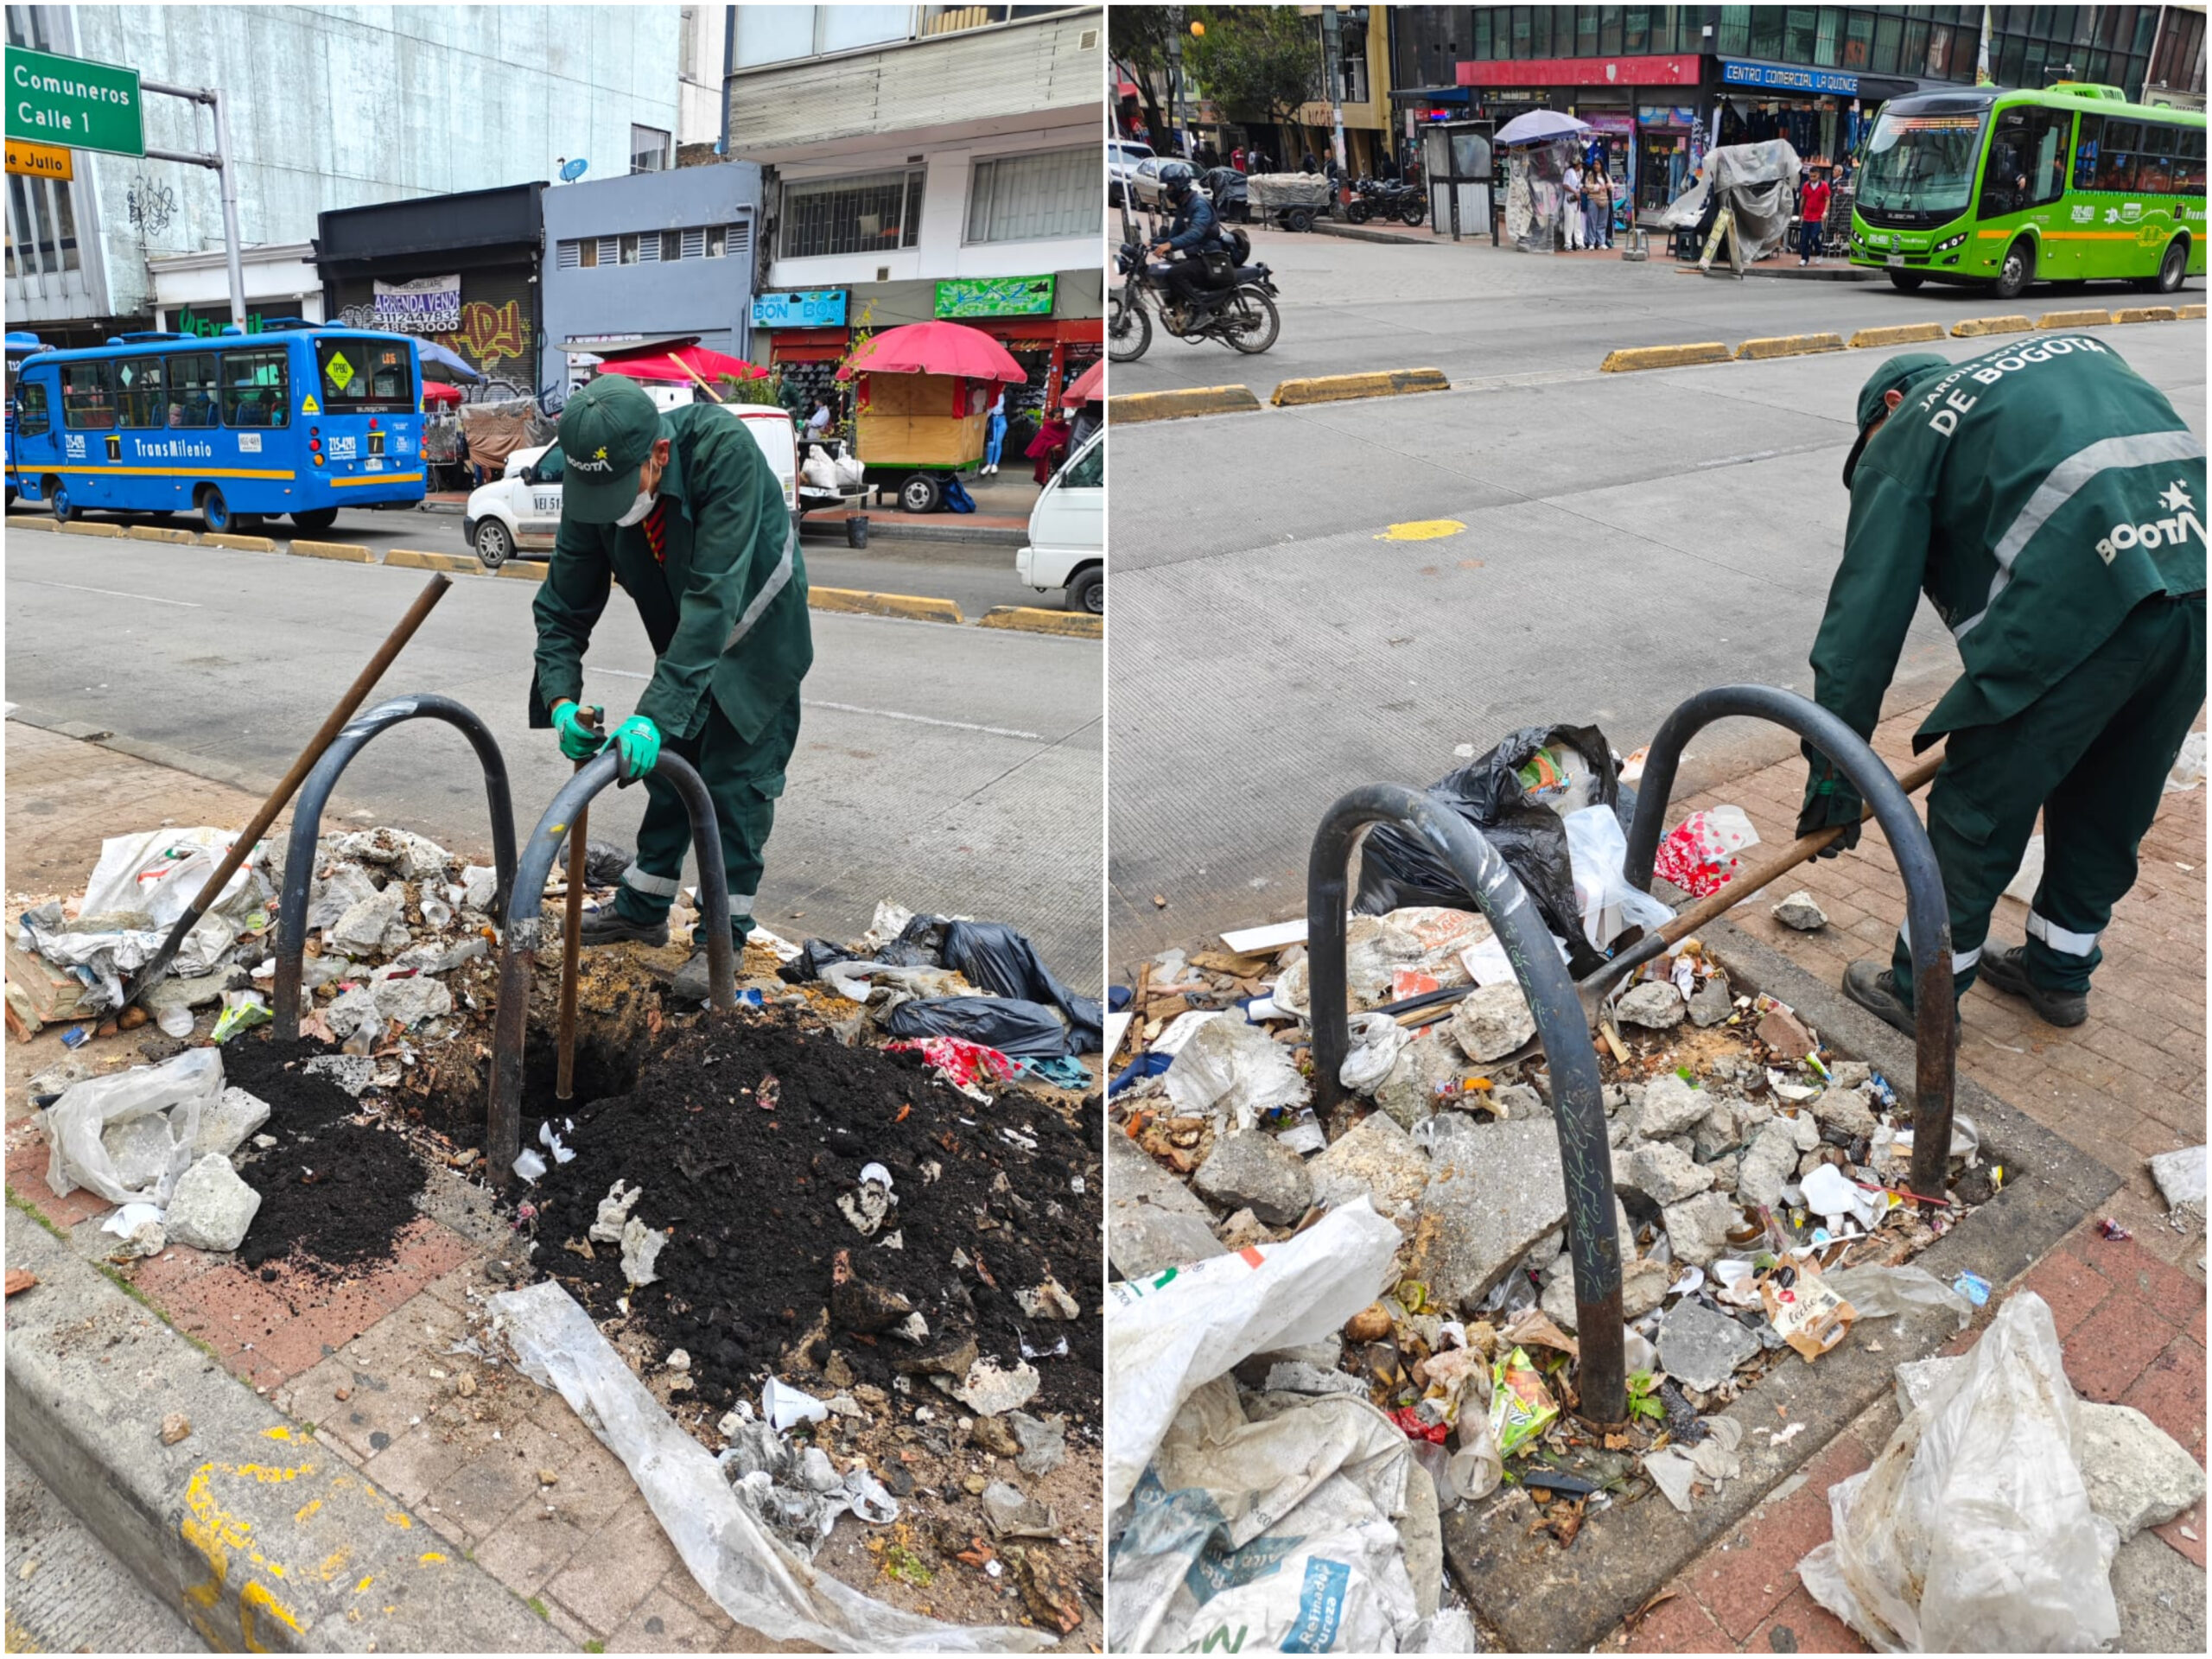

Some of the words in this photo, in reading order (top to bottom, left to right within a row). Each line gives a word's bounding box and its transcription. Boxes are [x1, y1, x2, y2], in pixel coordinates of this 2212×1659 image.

[13, 65, 130, 105] Comuneros
[1726, 65, 1762, 82] CENTRO
[1764, 70, 1813, 87] COMERCIAL
[1816, 74, 1827, 88] LA
[1827, 75, 1858, 92] QUINCE
[18, 101, 72, 130] Calle
[81, 111, 89, 133] 1
[753, 303, 788, 320] BON
[380, 321, 459, 333] 485-3000
[1929, 388, 1978, 438] DE
[135, 439, 212, 458] TransMilenio
